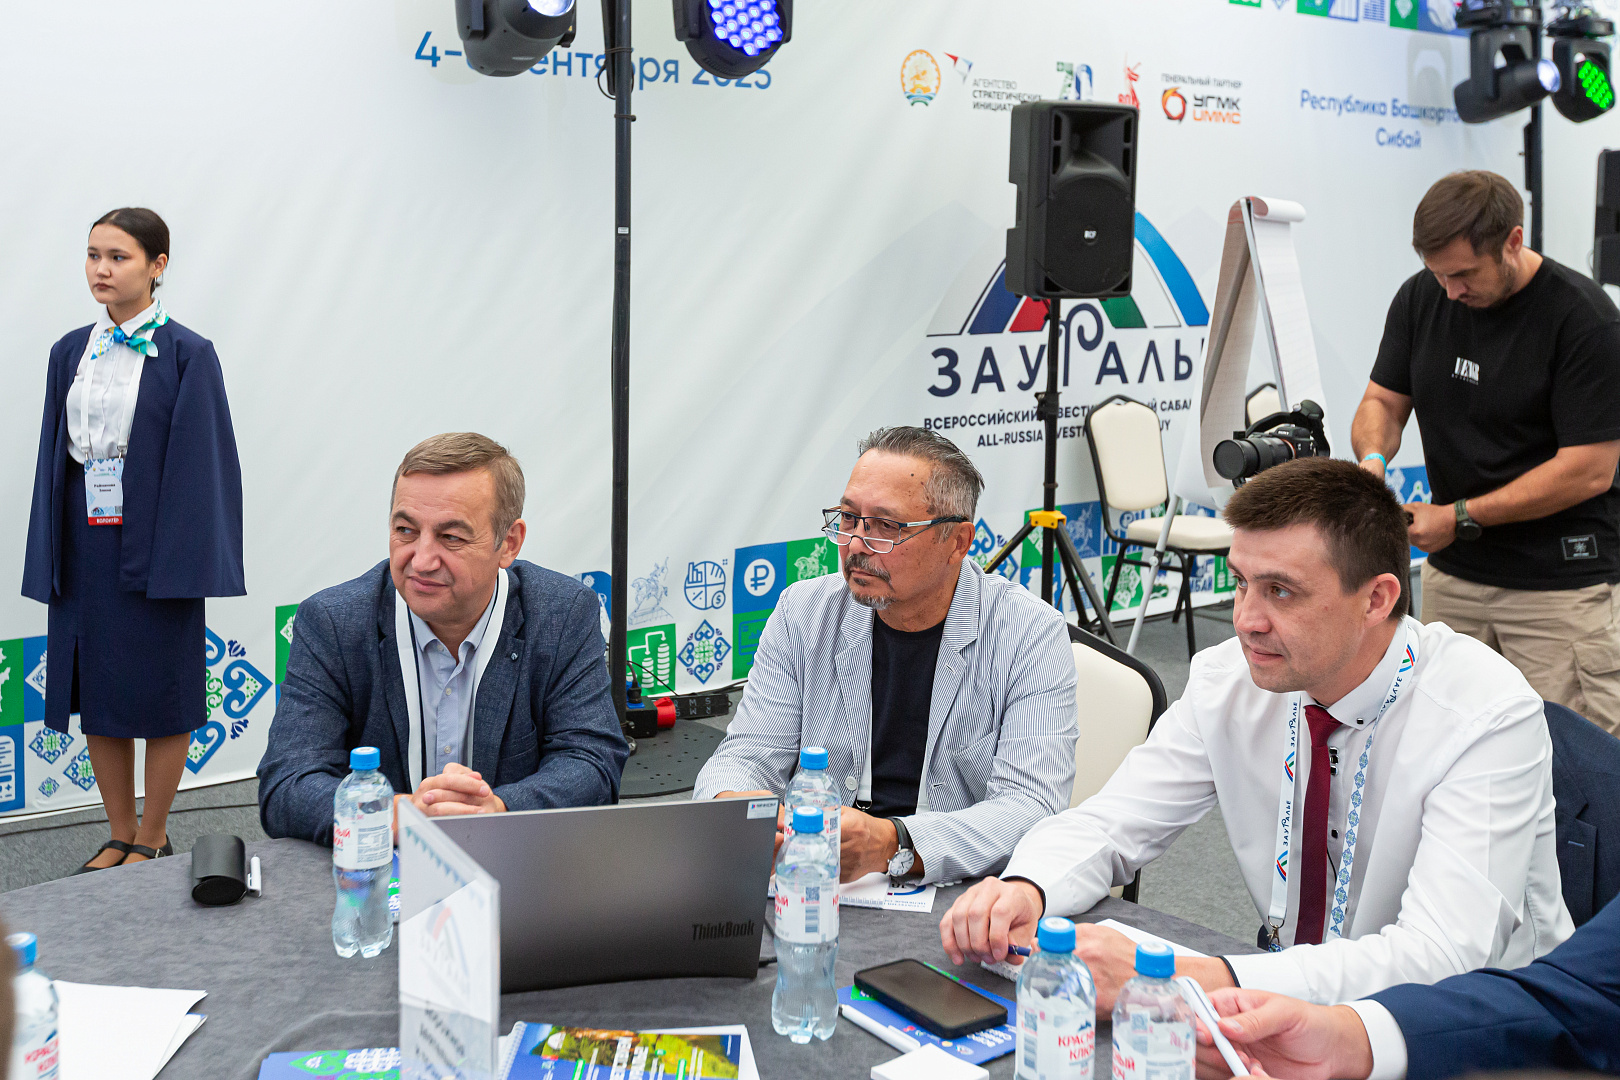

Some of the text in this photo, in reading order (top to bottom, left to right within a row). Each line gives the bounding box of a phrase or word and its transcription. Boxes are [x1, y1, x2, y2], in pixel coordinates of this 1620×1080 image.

[415, 30, 474, 70] 4-
[972, 78, 1017, 89] АГЕНТСТВО
[973, 101, 1013, 111] ИНИЦИАТ
[1193, 93, 1240, 110] УГМК
[1300, 90, 1461, 124] Республика Башкорто
[1193, 109, 1241, 124] UMMC
[1376, 127, 1422, 148] Сибай
[927, 303, 1205, 397] ЗАУРАЛЬ
[924, 406, 1038, 430] ВСЕРОССИЙСКИЙ
[977, 429, 1043, 447] ALL-RUSSIA
[1288, 702, 1298, 747] ЗАУРАЛЬЕ
[1281, 801, 1291, 846] ЗАУРАЛЬЕ
[692, 919, 754, 940] ThinkBook
